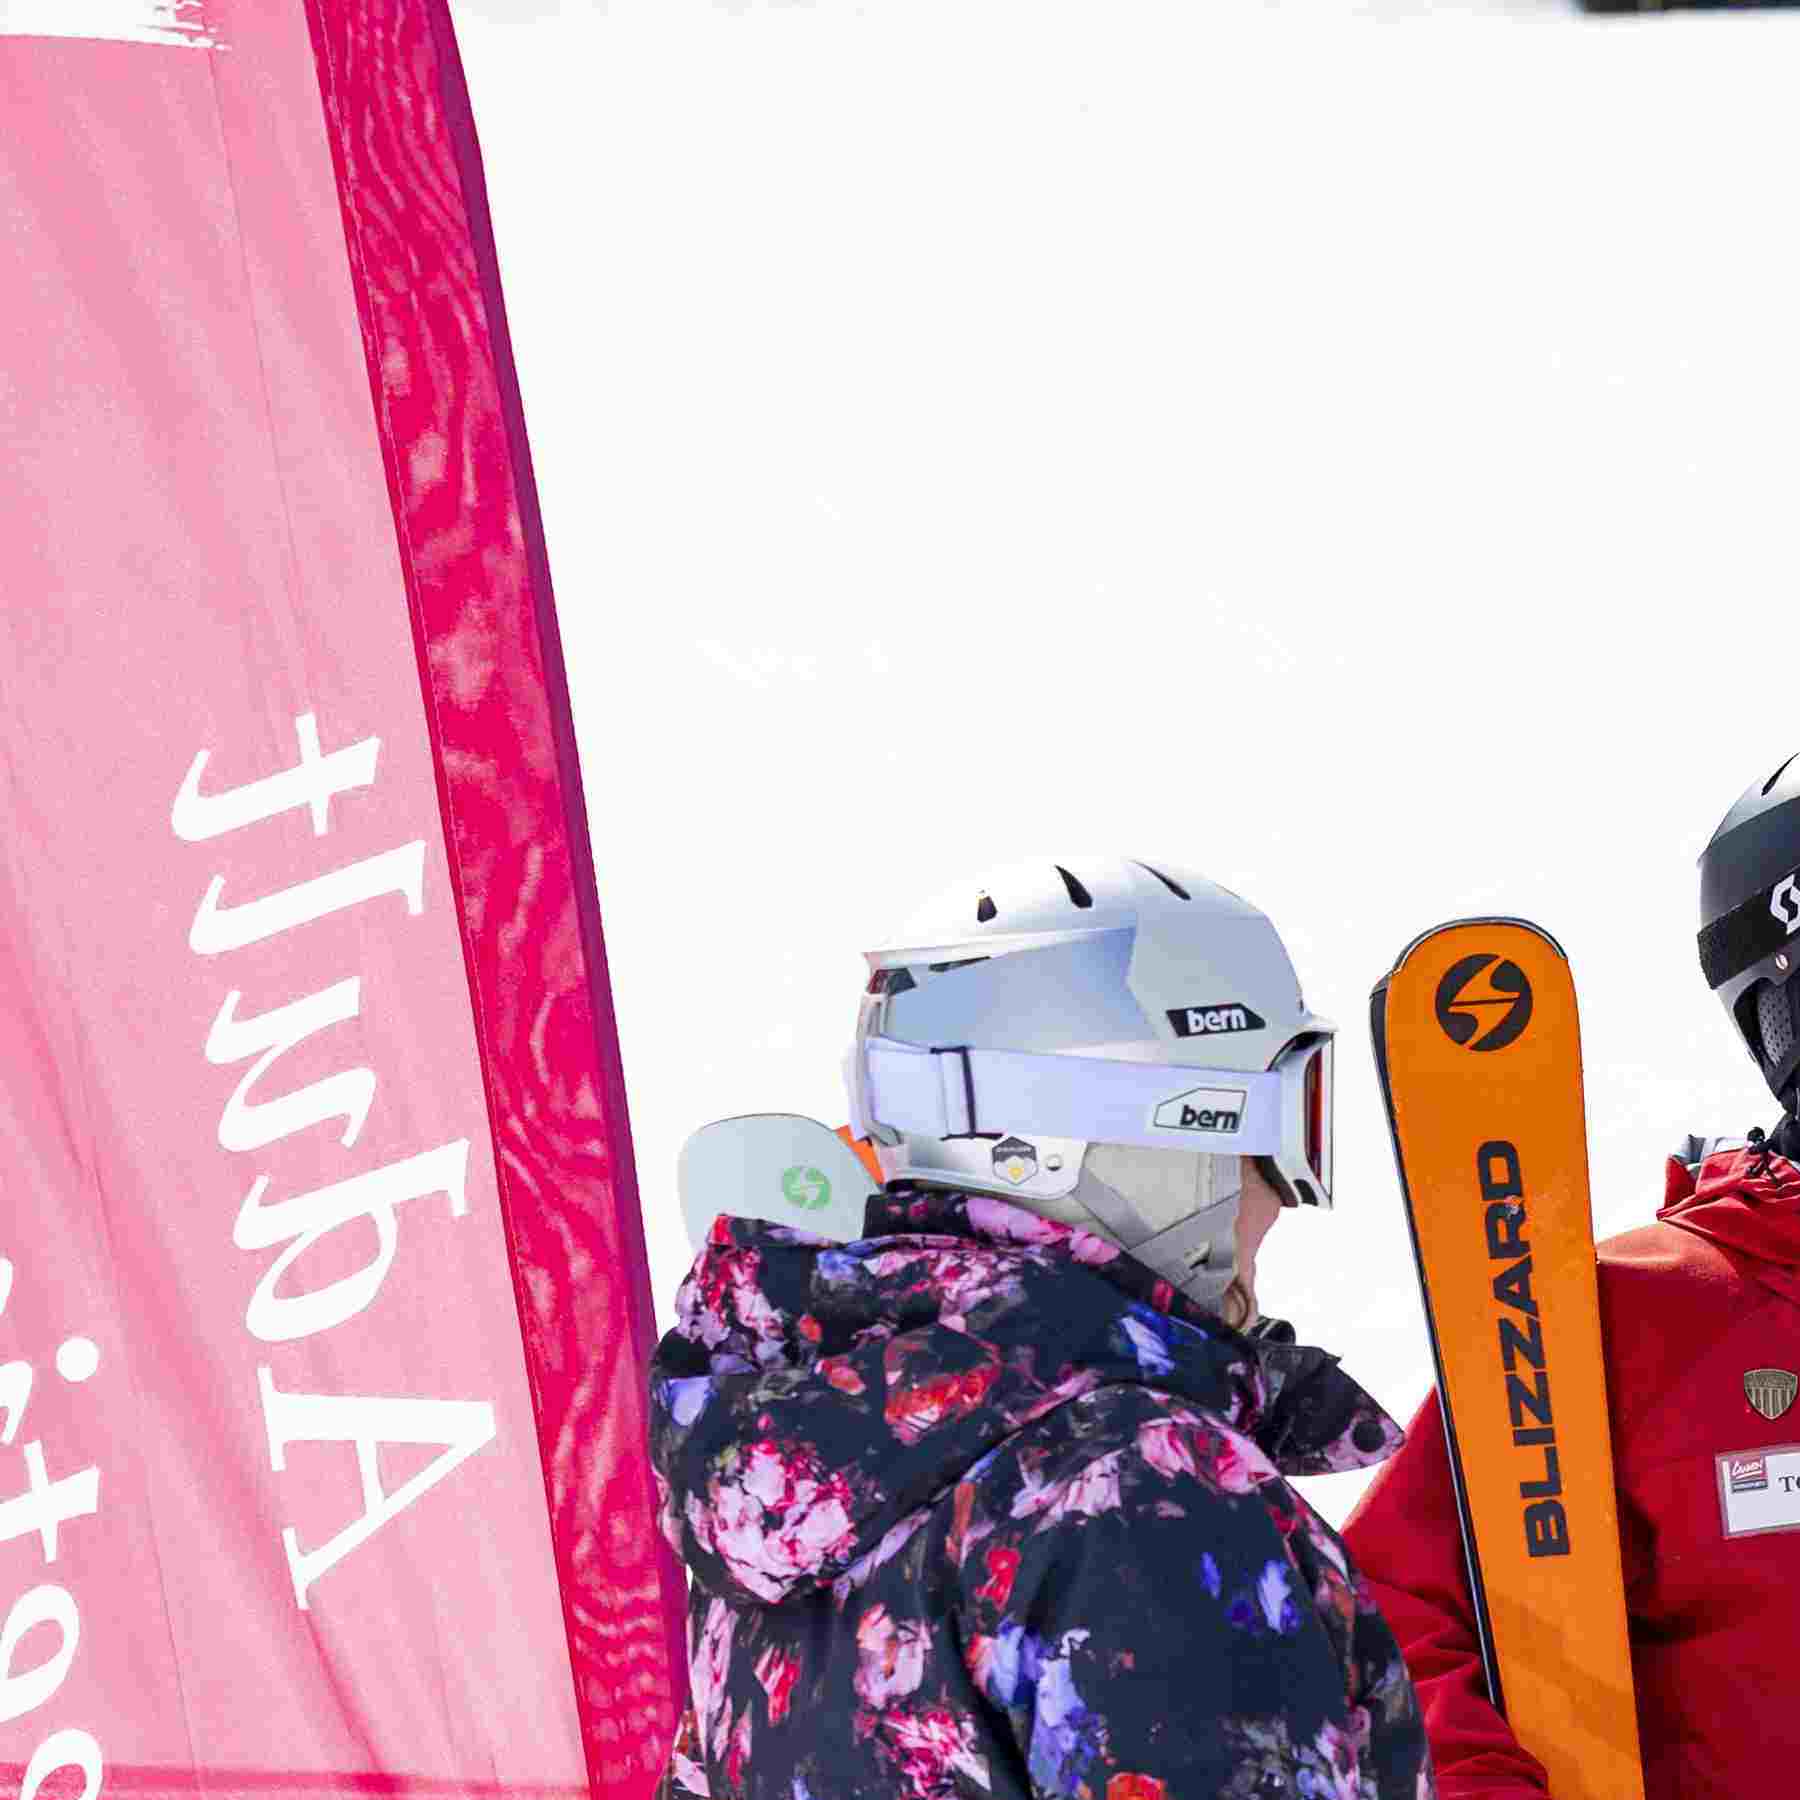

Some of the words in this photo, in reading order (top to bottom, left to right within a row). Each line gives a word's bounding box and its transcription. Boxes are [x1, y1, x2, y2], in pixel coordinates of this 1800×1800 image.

[1186, 1008, 1247, 1034] bern
[1180, 1104, 1238, 1130] bern
[1476, 1139, 1571, 1558] BLIZZARD
